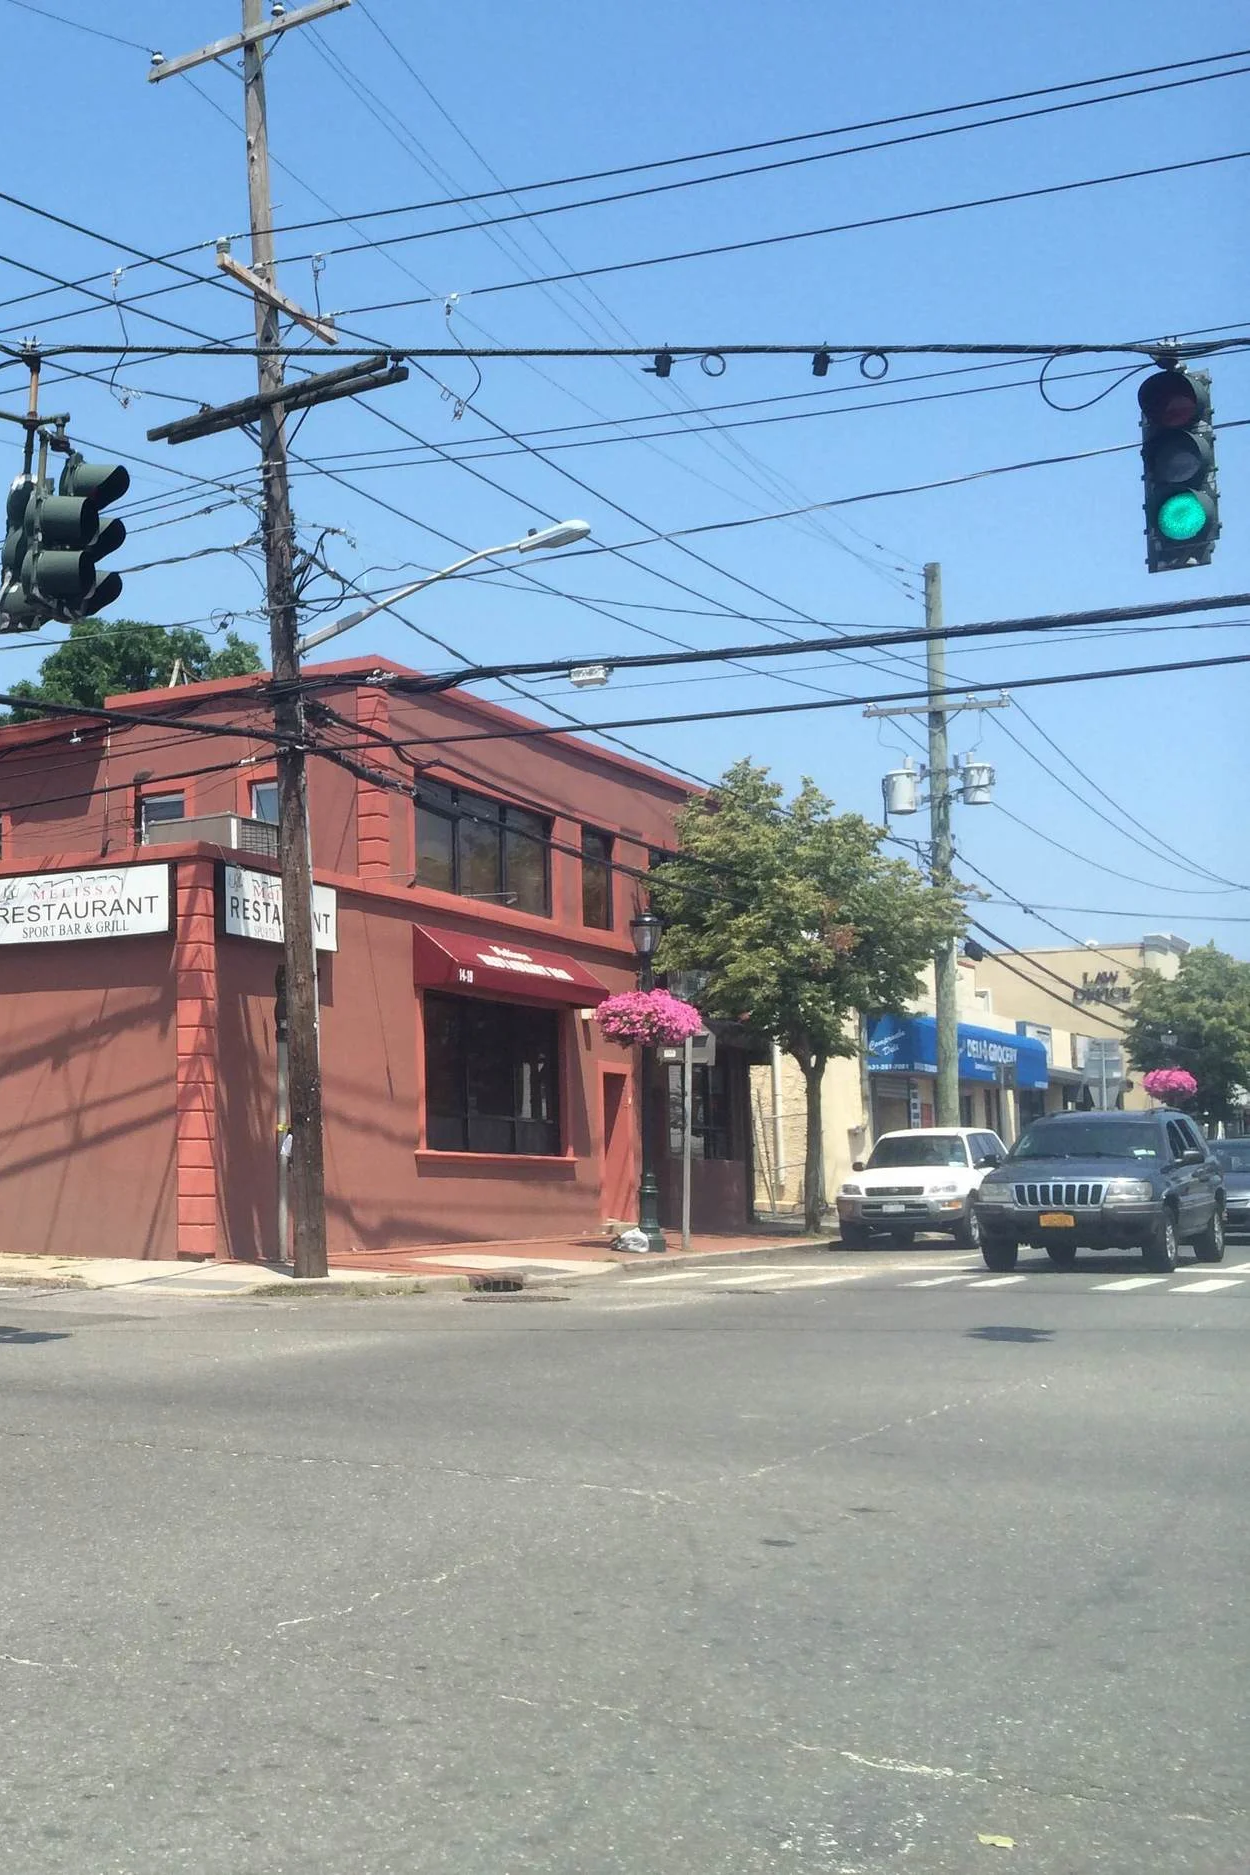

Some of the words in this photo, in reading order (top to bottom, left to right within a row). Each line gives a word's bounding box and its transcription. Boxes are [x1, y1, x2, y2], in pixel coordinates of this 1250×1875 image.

[32, 884, 118, 901] MELISSA
[230, 895, 331, 934] RESTANT
[22, 924, 55, 939] SPORT
[59, 922, 82, 936] BAR
[84, 921, 93, 934] &
[95, 919, 130, 933] GRILL
[1082, 970, 1120, 985] LAW
[966, 1038, 982, 1059] DELI
[989, 1042, 1018, 1065] GROCERY
